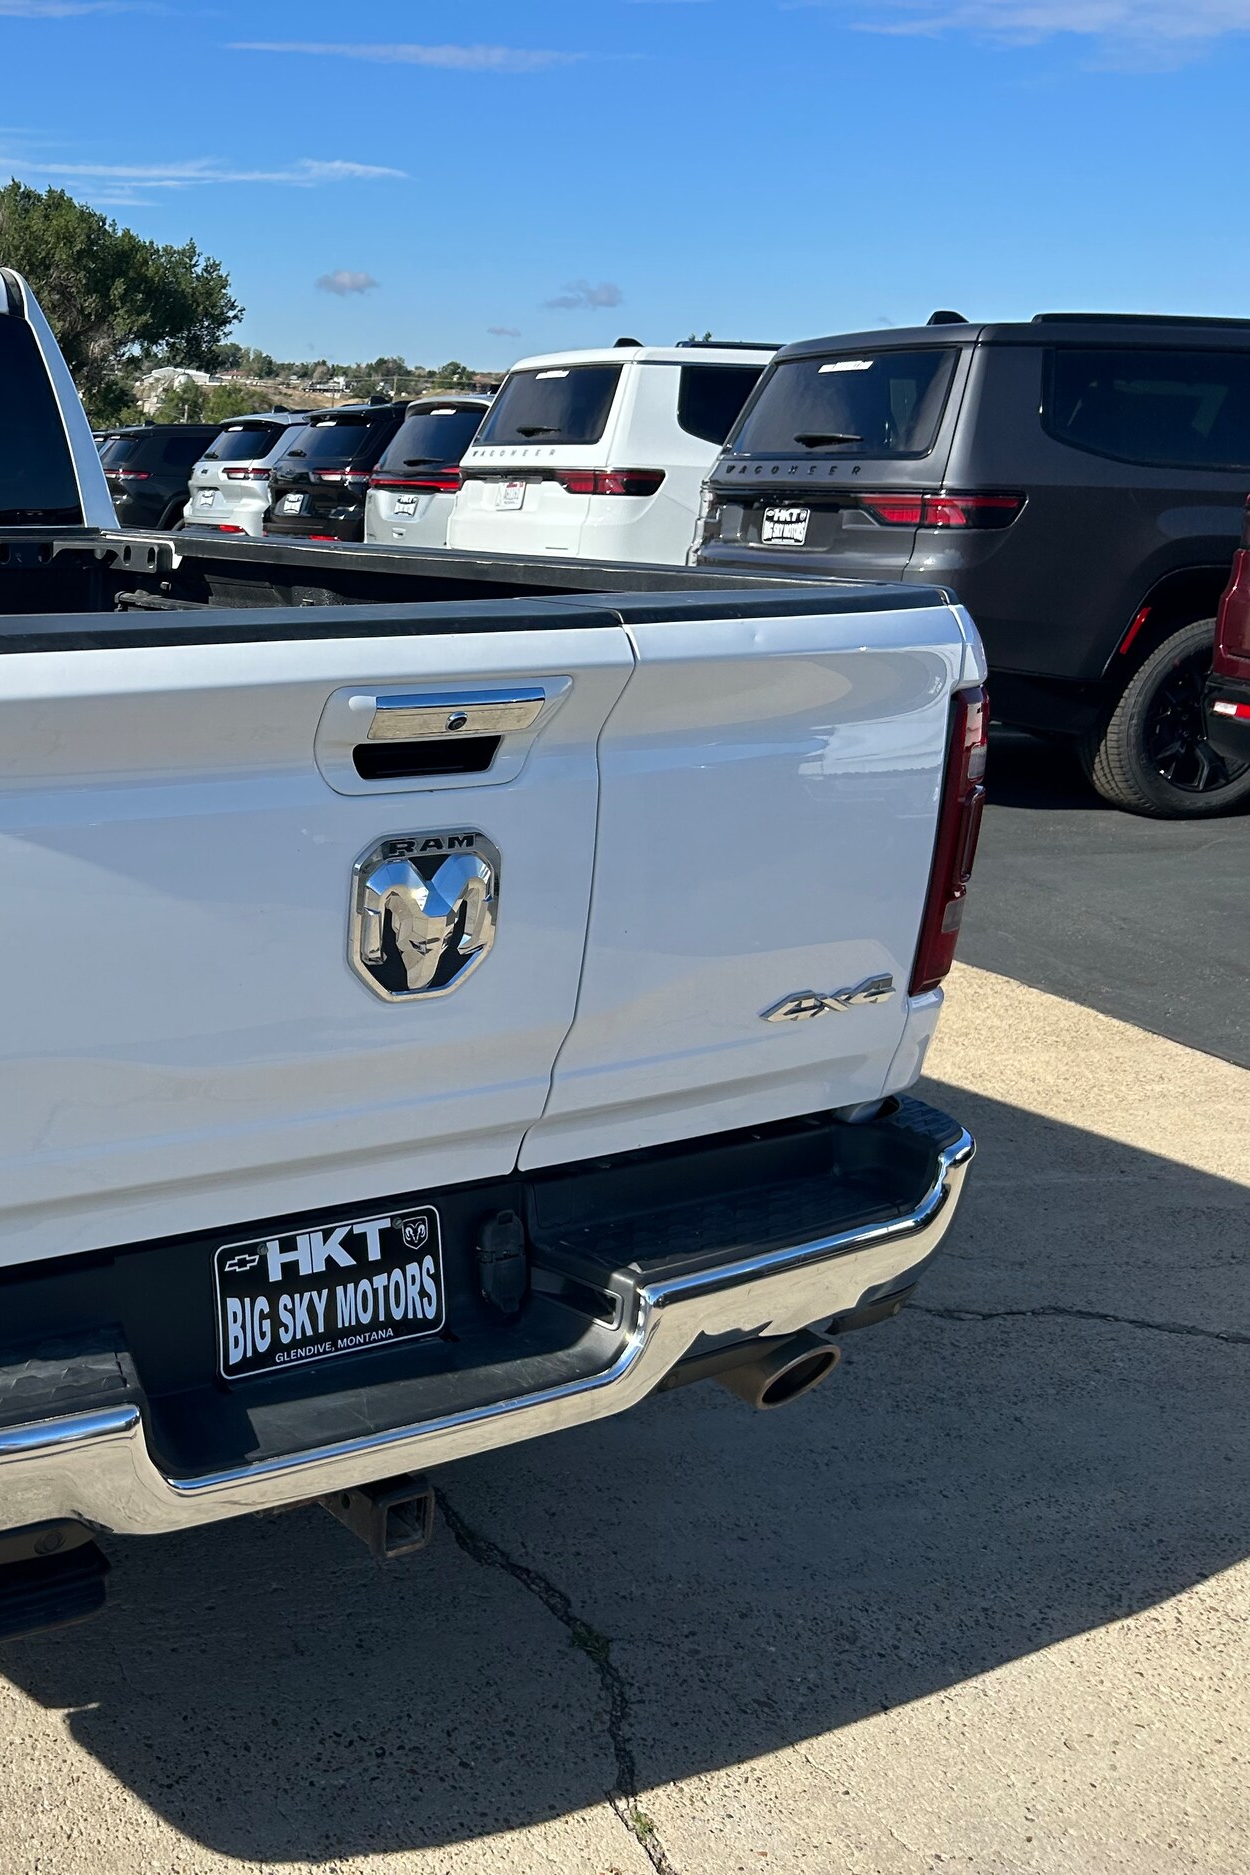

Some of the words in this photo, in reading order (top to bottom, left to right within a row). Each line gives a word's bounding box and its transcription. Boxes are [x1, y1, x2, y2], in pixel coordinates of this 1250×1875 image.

[725, 465, 862, 476] WAGONEER
[773, 508, 801, 522] HKT
[388, 833, 476, 856] RAM
[266, 1218, 391, 1283] HKT
[226, 1296, 272, 1366] BIG
[278, 1288, 329, 1344] SKY
[335, 1255, 438, 1329] MOTORS
[275, 1341, 336, 1363] GLENDIVE,
[337, 1327, 394, 1349] MONTANA
